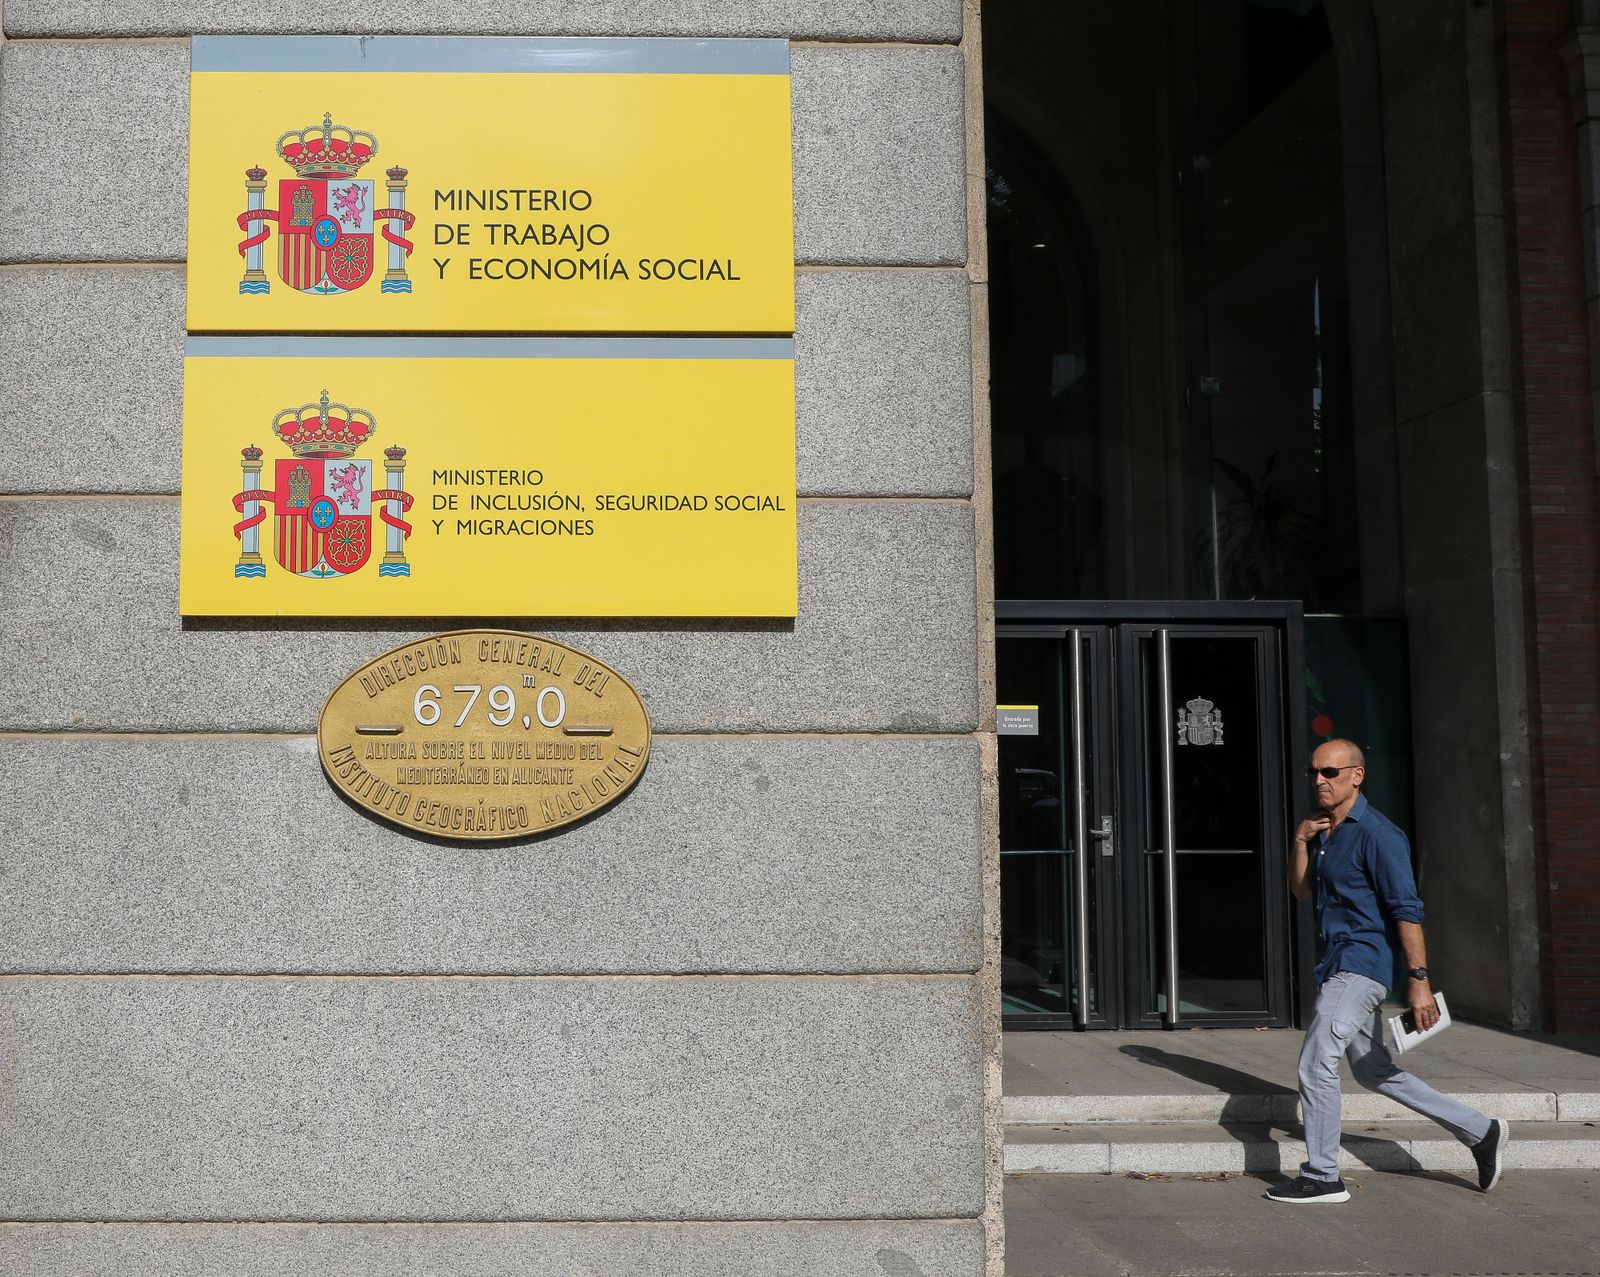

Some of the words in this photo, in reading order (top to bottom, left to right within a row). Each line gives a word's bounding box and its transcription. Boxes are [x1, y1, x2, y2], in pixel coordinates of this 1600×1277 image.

[434, 189, 592, 211] MINISTERIO
[434, 224, 470, 245] DE
[484, 224, 610, 252] TRABAJO
[433, 258, 451, 280] Y
[469, 253, 629, 280] ECONOMÍA
[639, 259, 741, 280] SOCIAL
[432, 470, 543, 485] MINISTERIO
[432, 495, 458, 511] DE
[471, 491, 585, 512] INCLUSIÓN,
[595, 495, 708, 511] SEGURIDAD
[714, 496, 786, 511] SOCIAL
[432, 520, 444, 535] Y
[456, 520, 594, 536] MIGRACIONES
[478, 638, 565, 677] GENERAL
[574, 663, 612, 698] DEL
[522, 672, 536, 689] m
[365, 741, 417, 760] ALTURA
[422, 741, 465, 760] SOBRE
[469, 741, 485, 760] EL
[491, 741, 532, 760] NIVEL
[536, 741, 576, 760] MEDIO
[580, 741, 604, 760] DEL
[396, 761, 490, 785] MEDITERRÁNEO
[492, 766, 509, 785] EN
[511, 766, 574, 785] ALICANTE
[329, 744, 413, 817] INSTITUTO
[413, 799, 530, 832] GEOGRÁFICO
[541, 743, 645, 824] NACIONAL
